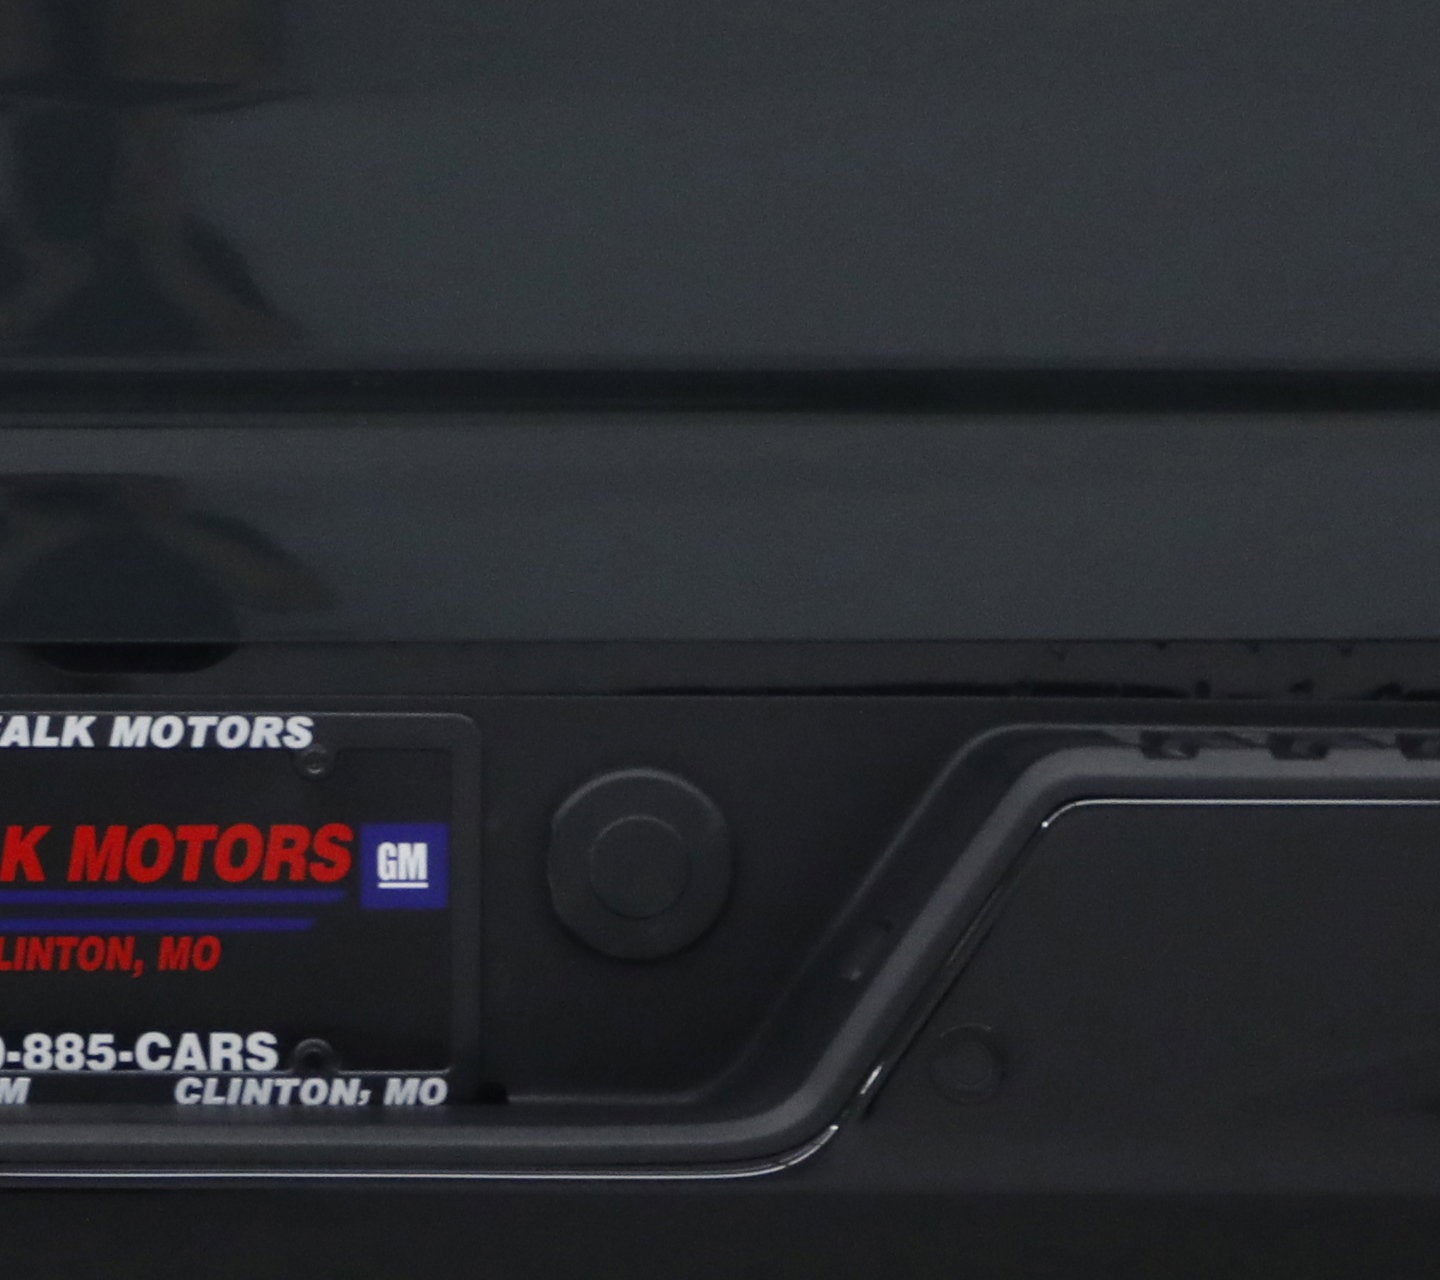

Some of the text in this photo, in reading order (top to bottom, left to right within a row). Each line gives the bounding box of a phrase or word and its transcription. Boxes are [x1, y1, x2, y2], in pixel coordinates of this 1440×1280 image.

[109, 715, 314, 749] MOTORS
[67, 823, 354, 883] MOTORS
[377, 841, 428, 881] GM
[158, 935, 221, 971] MO
[174, 1076, 447, 1106] CLINTON, MO
